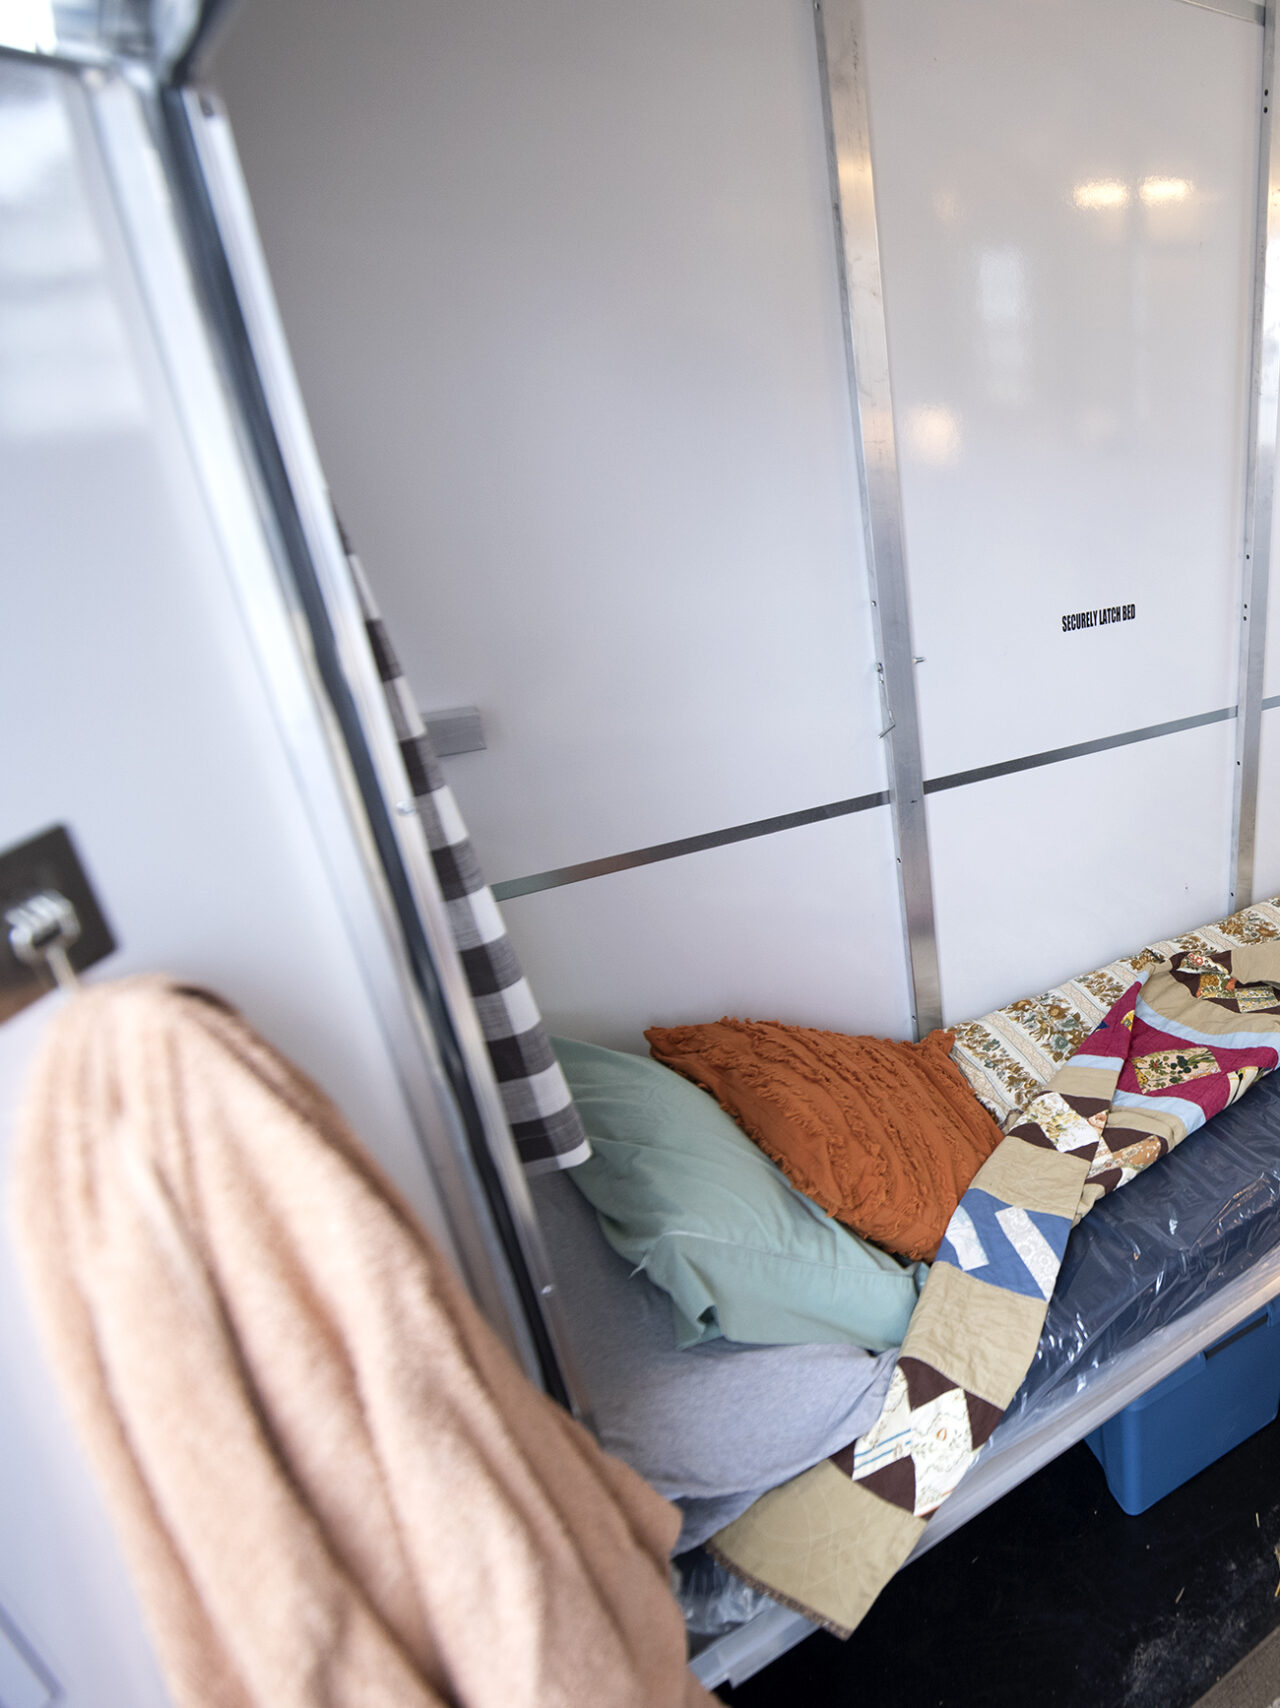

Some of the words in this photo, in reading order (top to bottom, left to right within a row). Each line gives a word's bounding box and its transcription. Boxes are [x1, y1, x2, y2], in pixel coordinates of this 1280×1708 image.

[1062, 610, 1098, 632] SECURELY
[1099, 606, 1121, 625] LATCH
[1122, 603, 1136, 621] BED
